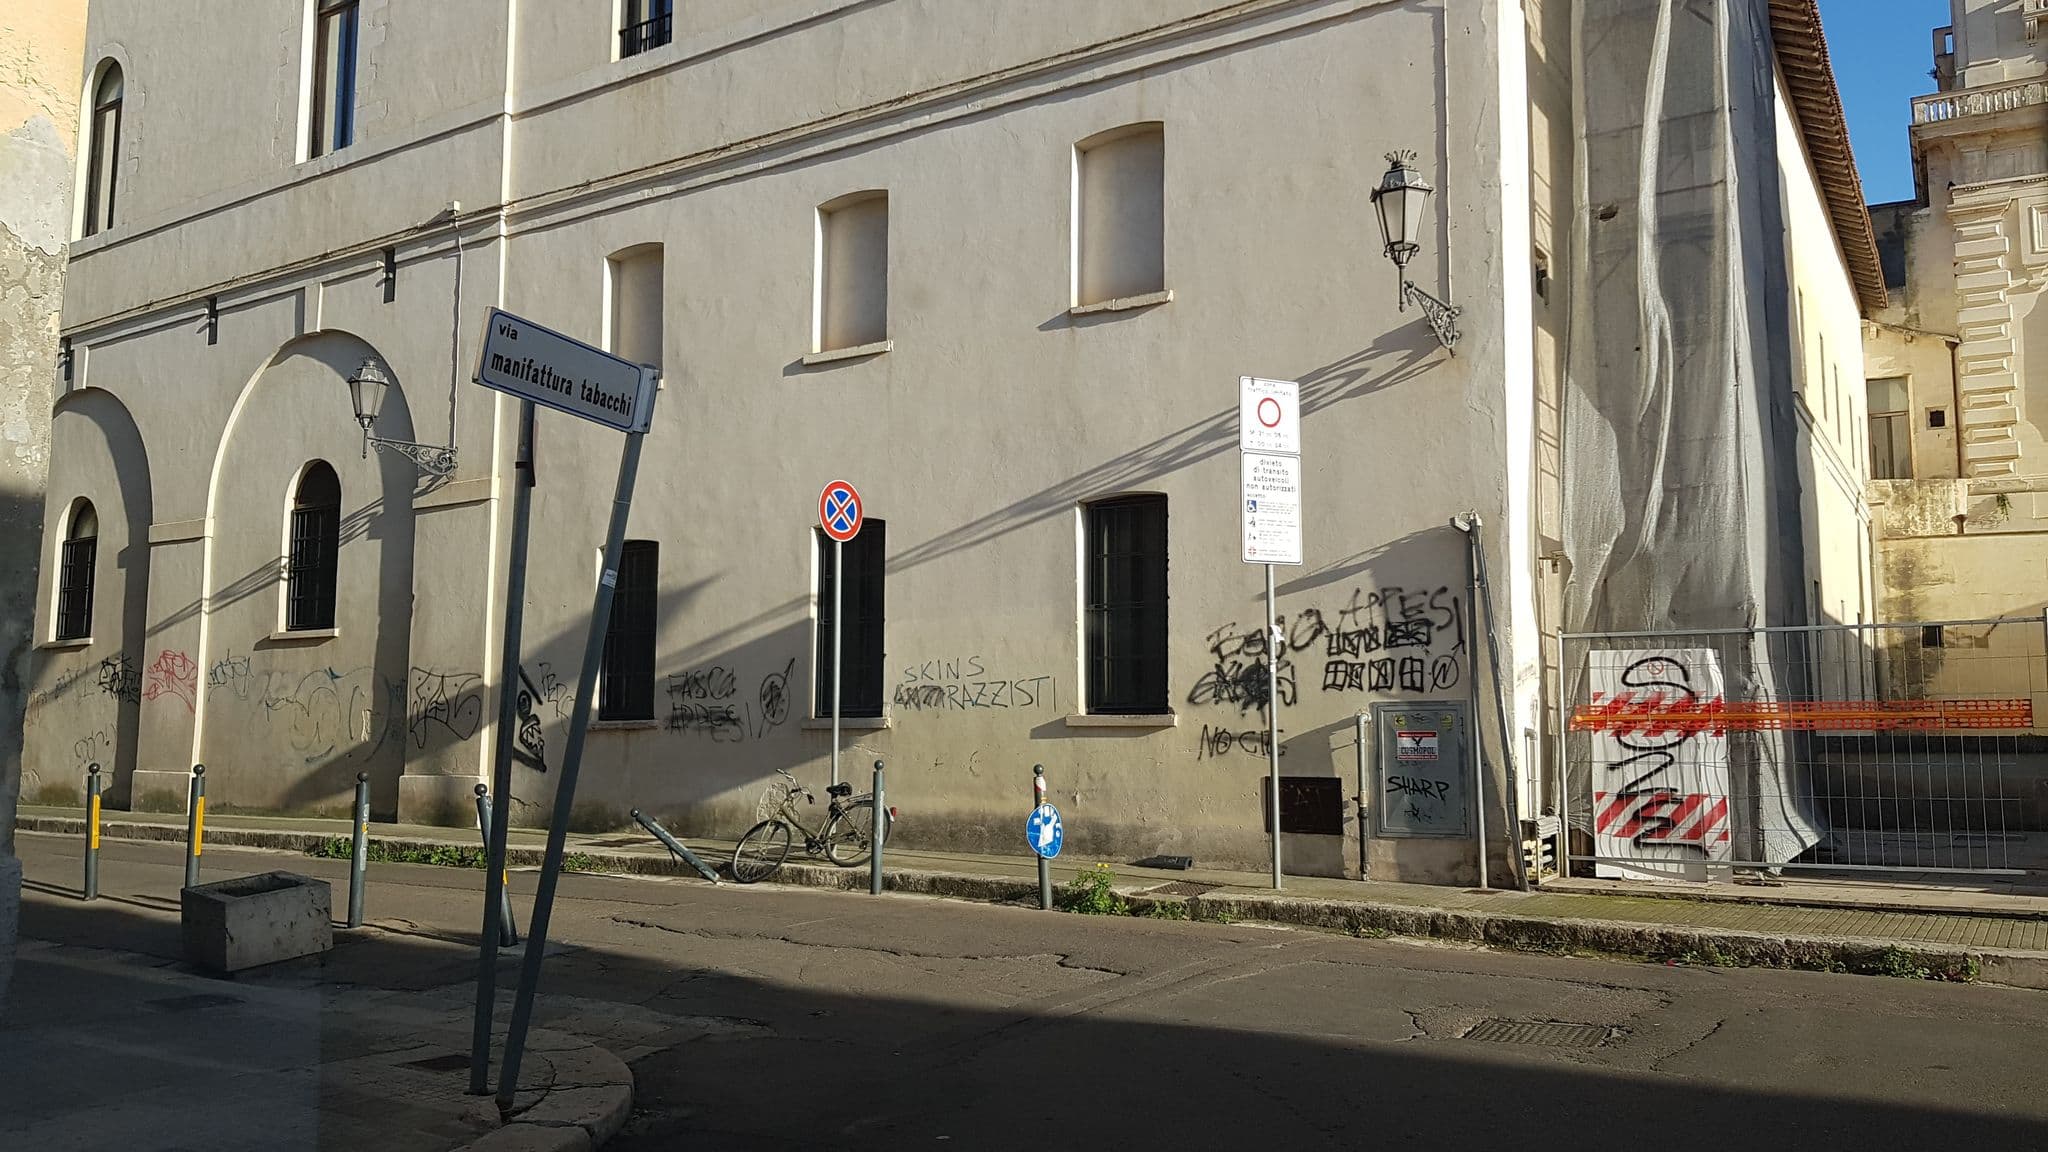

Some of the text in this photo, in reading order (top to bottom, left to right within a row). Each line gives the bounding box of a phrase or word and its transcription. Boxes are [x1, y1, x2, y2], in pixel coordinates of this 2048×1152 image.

[499, 323, 518, 340] via
[491, 351, 632, 417] manifattura tabacchi
[904, 655, 985, 683] SKINS
[1386, 775, 1449, 801] SHARP
